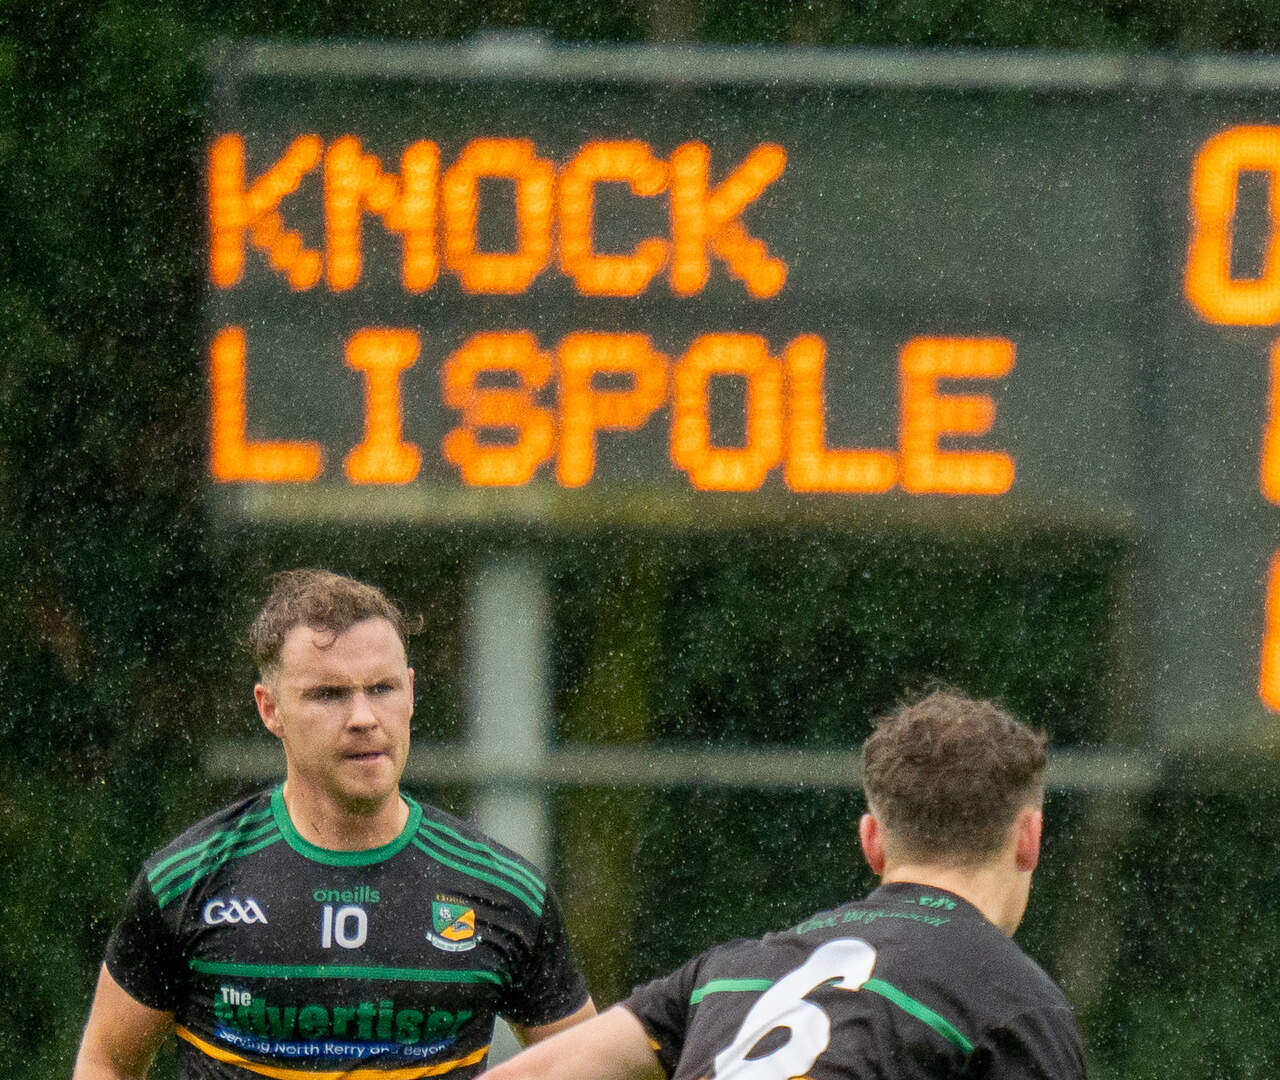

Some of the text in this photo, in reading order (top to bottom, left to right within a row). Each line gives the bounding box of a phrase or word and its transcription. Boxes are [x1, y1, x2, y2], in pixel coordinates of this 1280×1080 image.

[207, 133, 788, 299] KNOCK
[207, 325, 1017, 495] LISPOLE
[204, 899, 268, 925] GAA
[321, 904, 368, 949] 10
[220, 987, 252, 1007] The
[274, 1043, 320, 1056] North
[324, 1042, 366, 1057] Kerry
